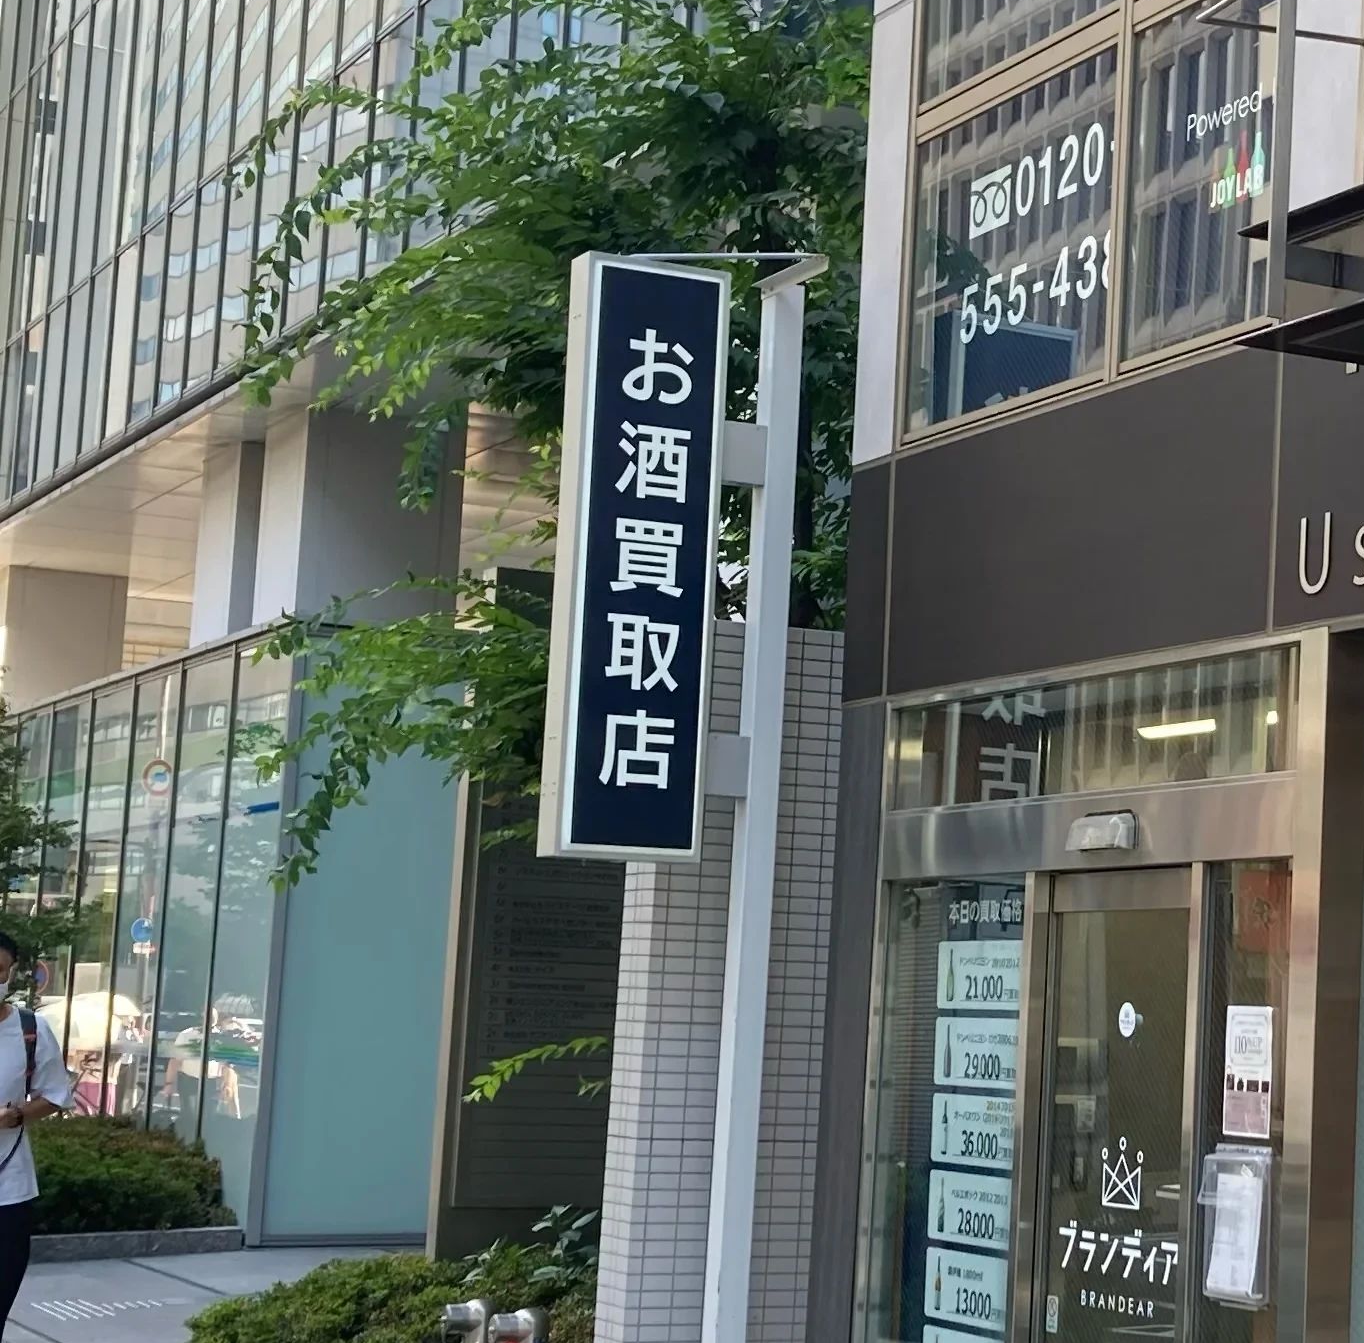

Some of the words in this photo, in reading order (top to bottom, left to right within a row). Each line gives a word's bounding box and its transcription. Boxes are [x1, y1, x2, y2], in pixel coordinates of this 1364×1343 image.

[1187, 84, 1262, 142] Powered
[598, 328, 695, 790] お酒買取店
[1299, 511, 1331, 594] U
[948, 899, 1023, 925] 本日の買取価格
[1059, 1219, 1179, 1286] ブランディア
[1080, 1289, 1155, 1319] BRANDEAR
